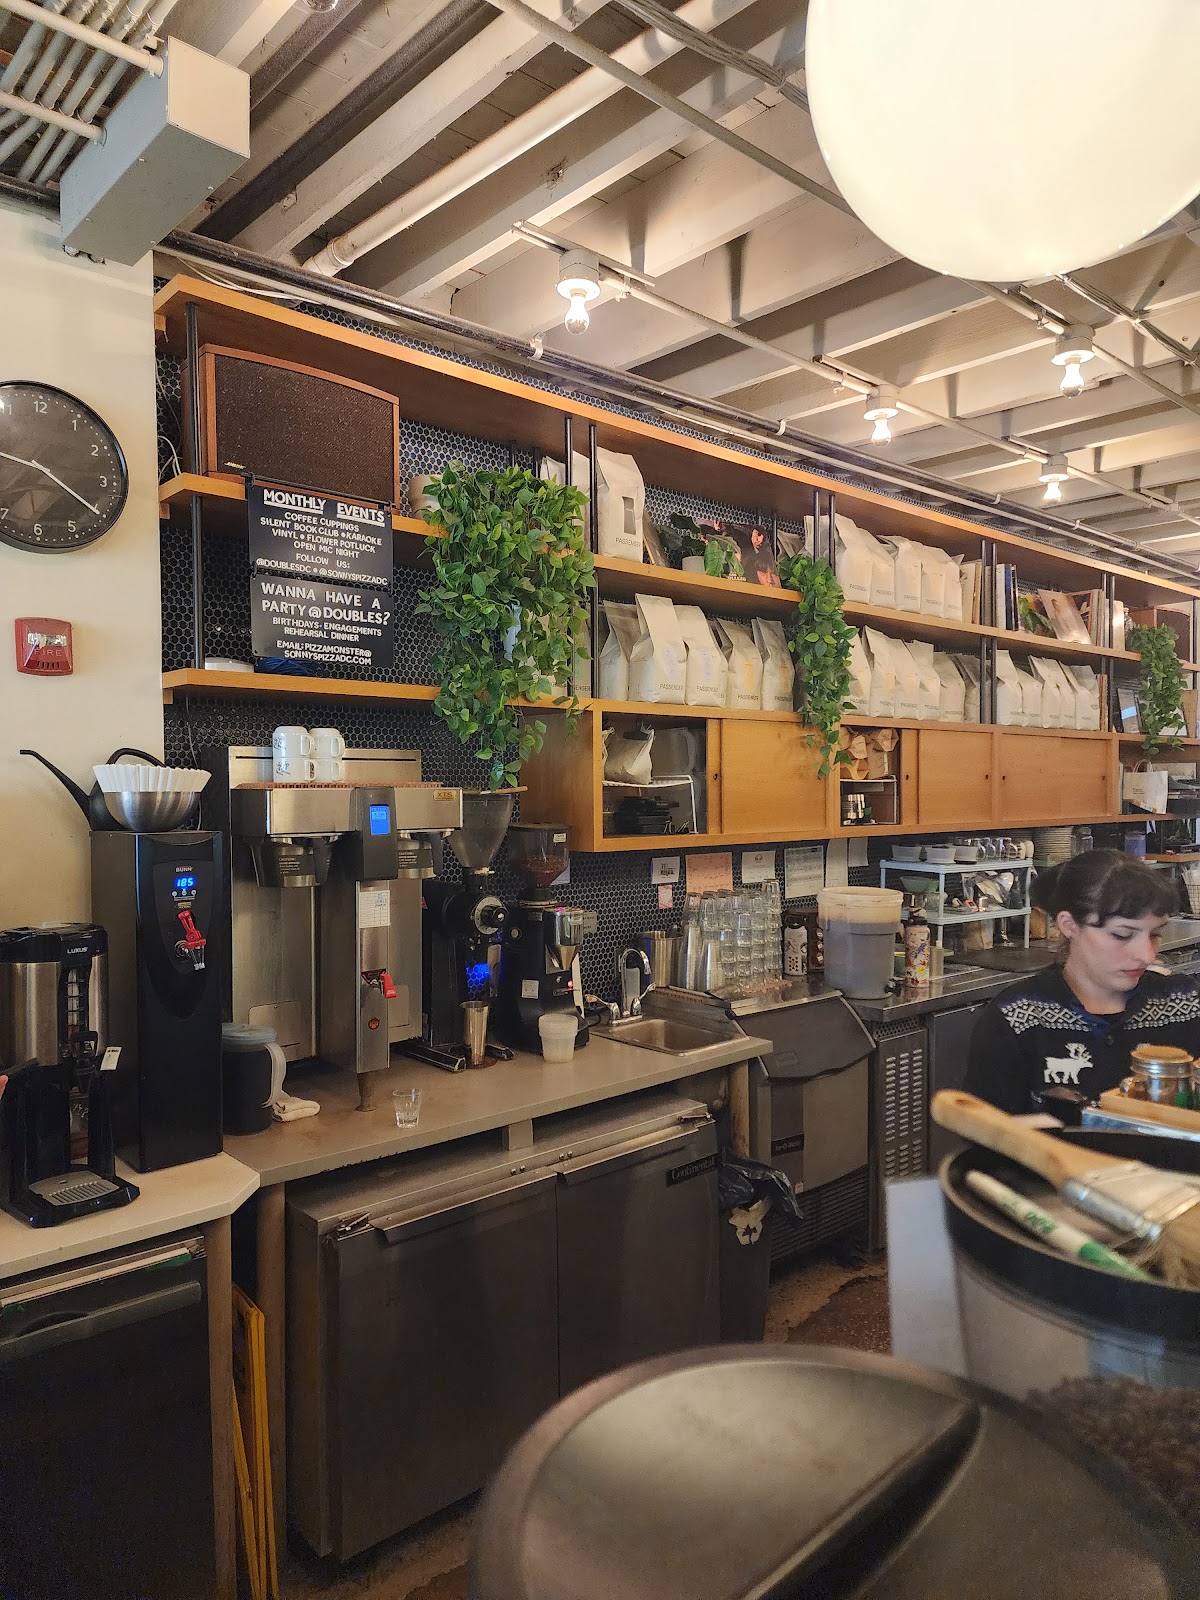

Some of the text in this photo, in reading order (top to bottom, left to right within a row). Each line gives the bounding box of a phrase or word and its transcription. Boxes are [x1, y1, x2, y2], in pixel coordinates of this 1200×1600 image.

[34, 400, 48, 414] 12
[72, 420, 77, 431] 1
[91, 444, 99, 456] 2
[100, 476, 108, 488] 3
[263, 489, 385, 523] MONTHLY EVENTS
[0, 508, 9, 519] 7
[68, 520, 76, 532] 5
[284, 512, 359, 532] COFFEE CUPPINGS
[33, 524, 42, 536] 6
[260, 517, 382, 546] SILENT BOOK CLUB KARAOKE
[272, 528, 376, 553] VINYL FLOWER POTLUCK
[294, 541, 360, 559] OPEN MIC NIGHT
[296, 553, 350, 569] FOLLOW US:
[256, 558, 388, 585] @DOUBLESDC @SONNYSPIZZADC
[261, 582, 381, 610] WANNA HAVE A
[262, 600, 306, 617] PARTY
[323, 607, 390, 625] DOUBLES?
[284, 627, 359, 642] REHEARSAL DINNER
[324, 622, 382, 636] ENGAGEMENTS
[35, 649, 62, 657] FIRE
[176, 878, 194, 887] 185
